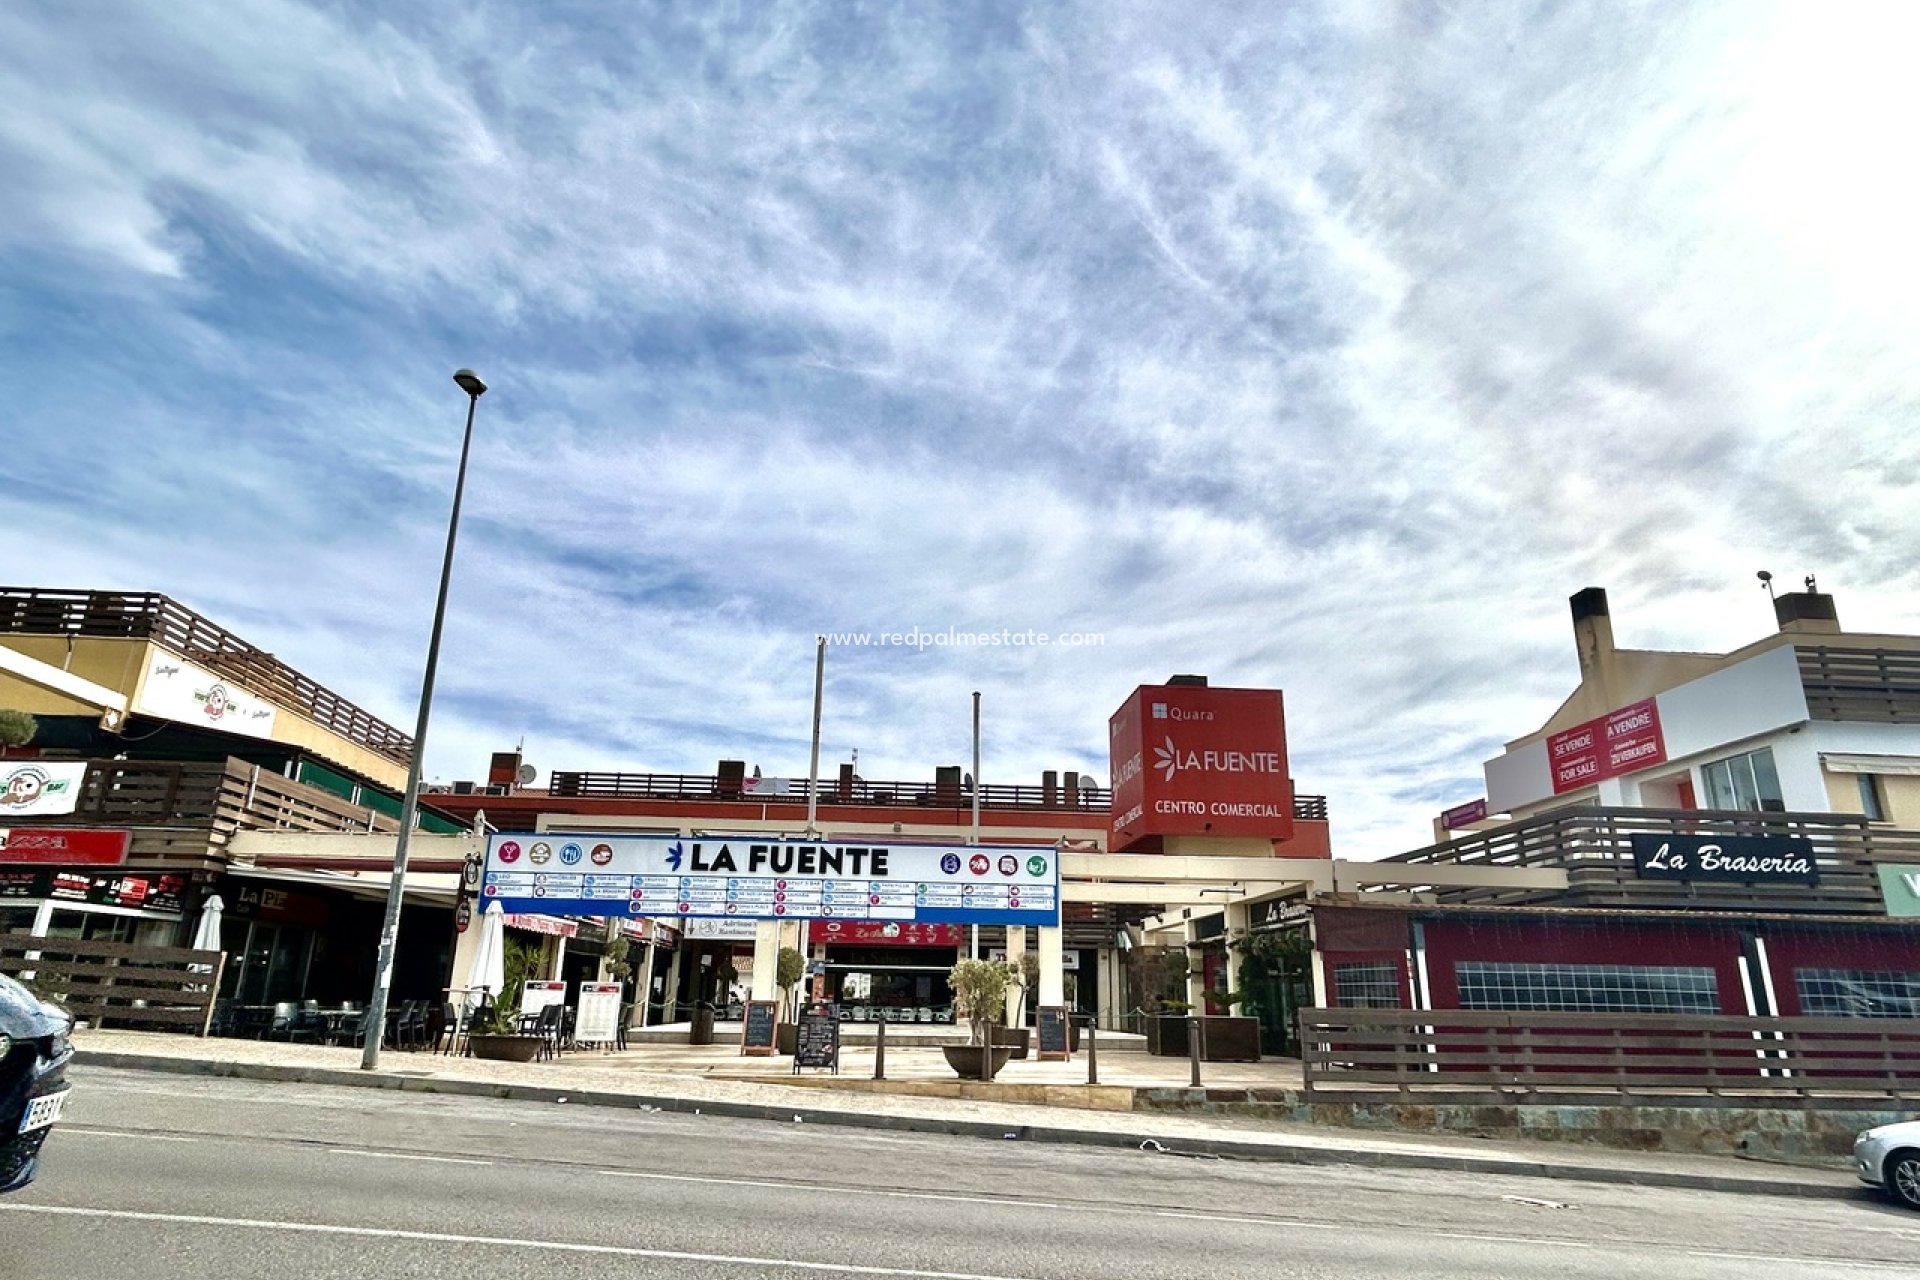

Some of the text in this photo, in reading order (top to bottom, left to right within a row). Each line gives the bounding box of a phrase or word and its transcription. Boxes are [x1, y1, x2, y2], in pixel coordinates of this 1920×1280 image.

[1170, 707, 1214, 721] Quara
[1616, 713, 1651, 734] VENDRE
[1566, 734, 1591, 752] VENDE
[1176, 750, 1279, 773] LA FUENTE
[1560, 761, 1596, 781] FOR SALE
[1155, 800, 1282, 818] CENTRO COMERCIAL
[691, 843, 889, 876] LA FUENTE
[1645, 843, 1811, 874] La Brasería
